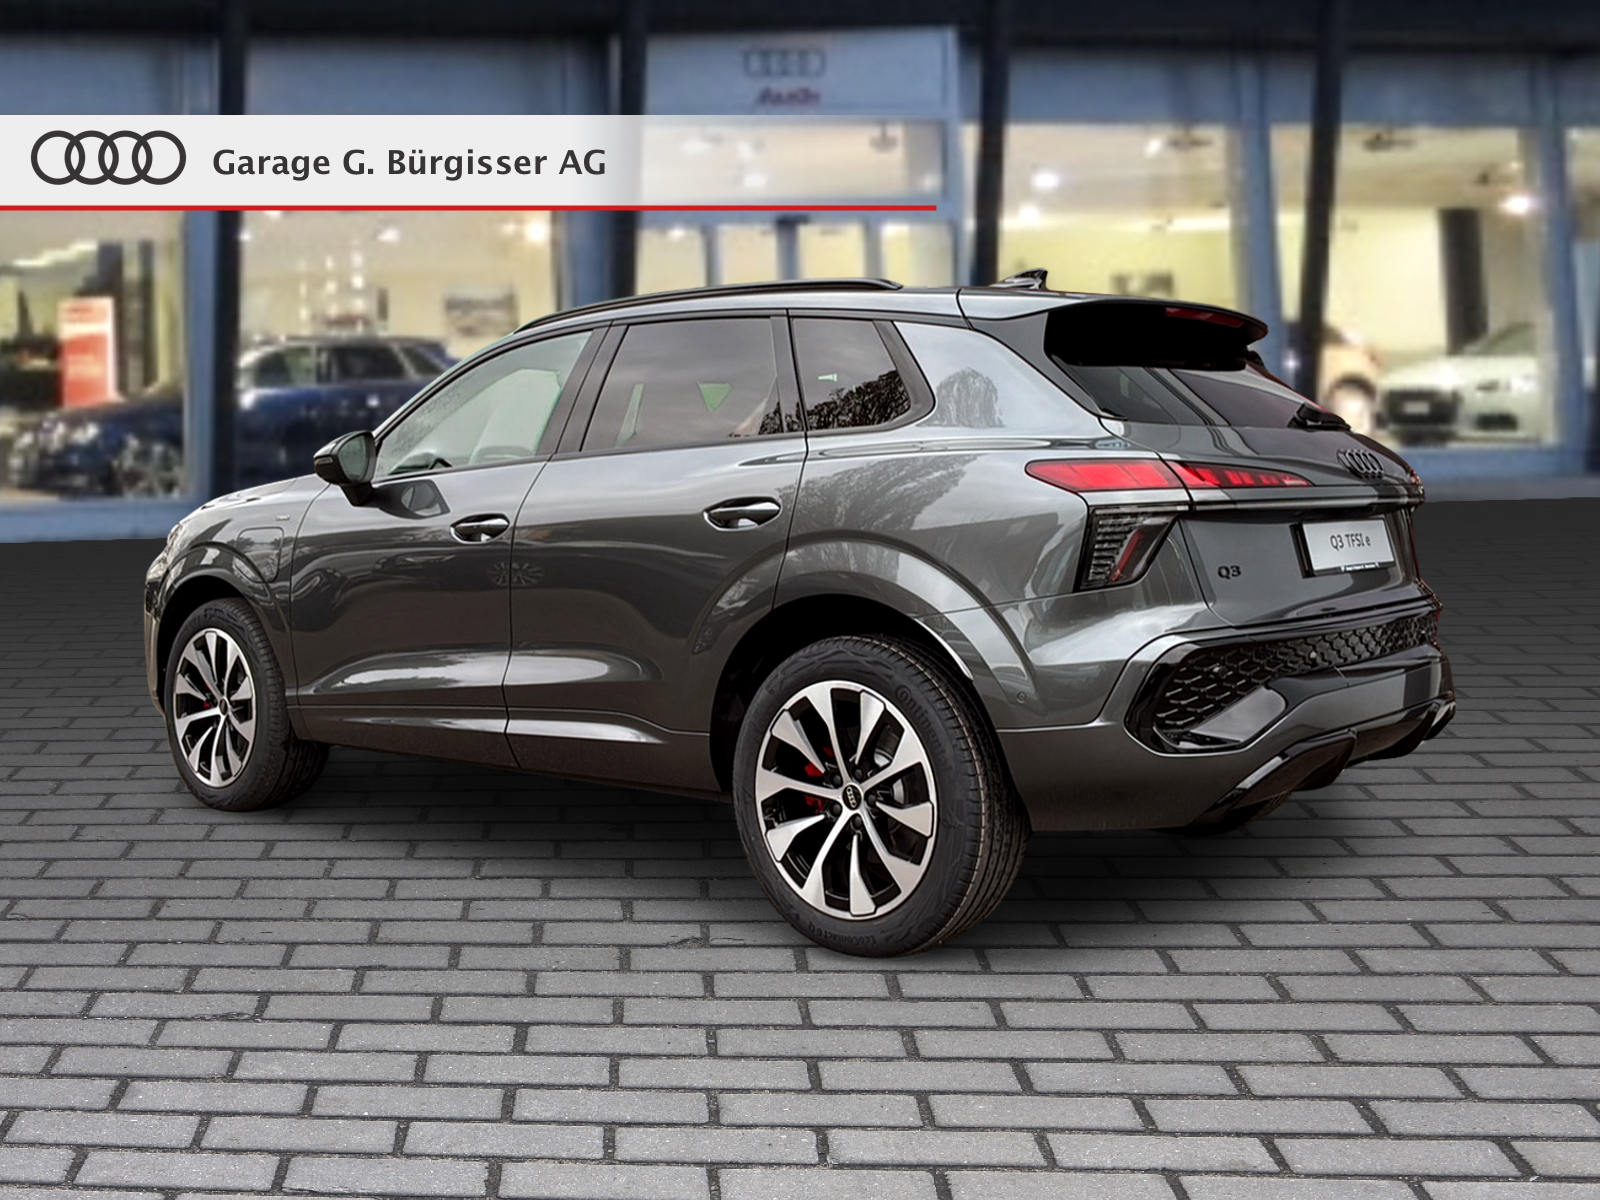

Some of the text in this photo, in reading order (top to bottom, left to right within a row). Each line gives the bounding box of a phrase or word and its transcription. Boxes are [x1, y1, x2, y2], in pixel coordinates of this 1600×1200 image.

[1330, 533, 1371, 550] Q3 TFSI e
[1217, 565, 1242, 579] Q3
